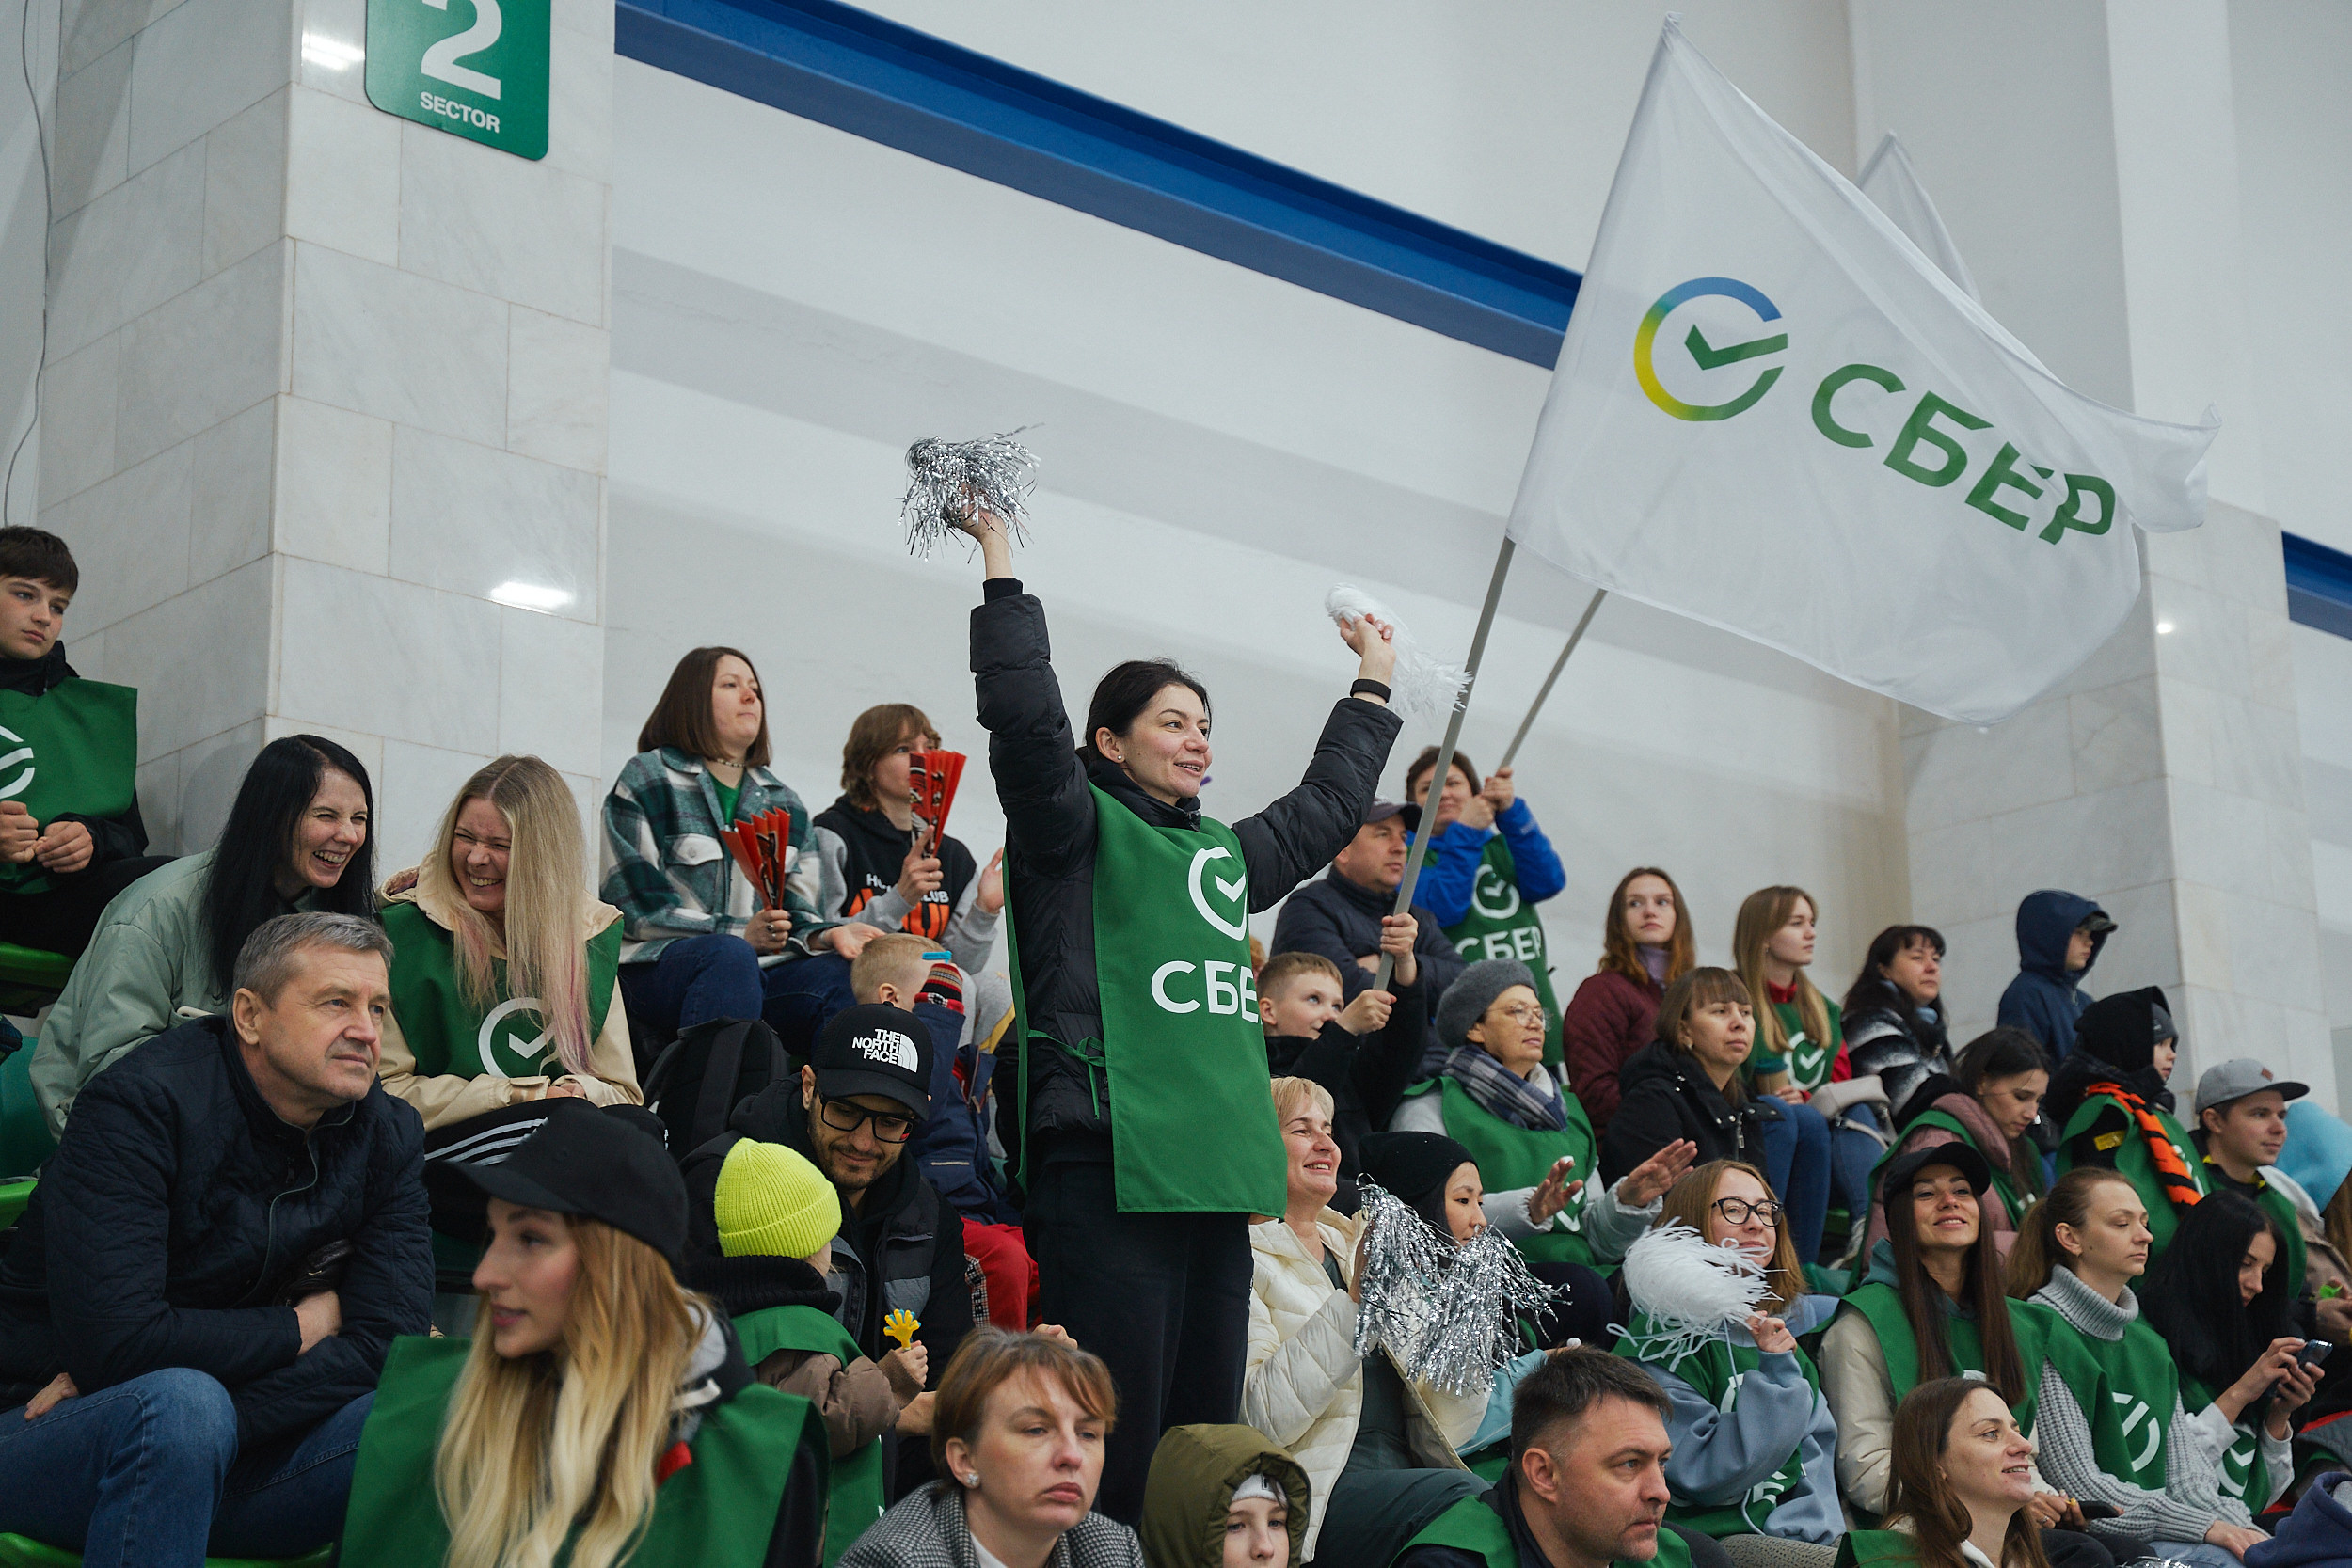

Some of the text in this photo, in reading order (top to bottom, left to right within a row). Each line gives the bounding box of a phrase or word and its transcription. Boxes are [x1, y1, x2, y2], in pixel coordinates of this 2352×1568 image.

[421, 0, 501, 101] 2
[420, 91, 501, 134] SECTOR
[1811, 363, 2116, 546] СБЕР
[921, 890, 950, 903] LUB
[1151, 960, 1263, 1025] СБЕ
[851, 1037, 899, 1054] NORTH
[874, 1028, 900, 1043] THE
[863, 1048, 898, 1065] FACE
